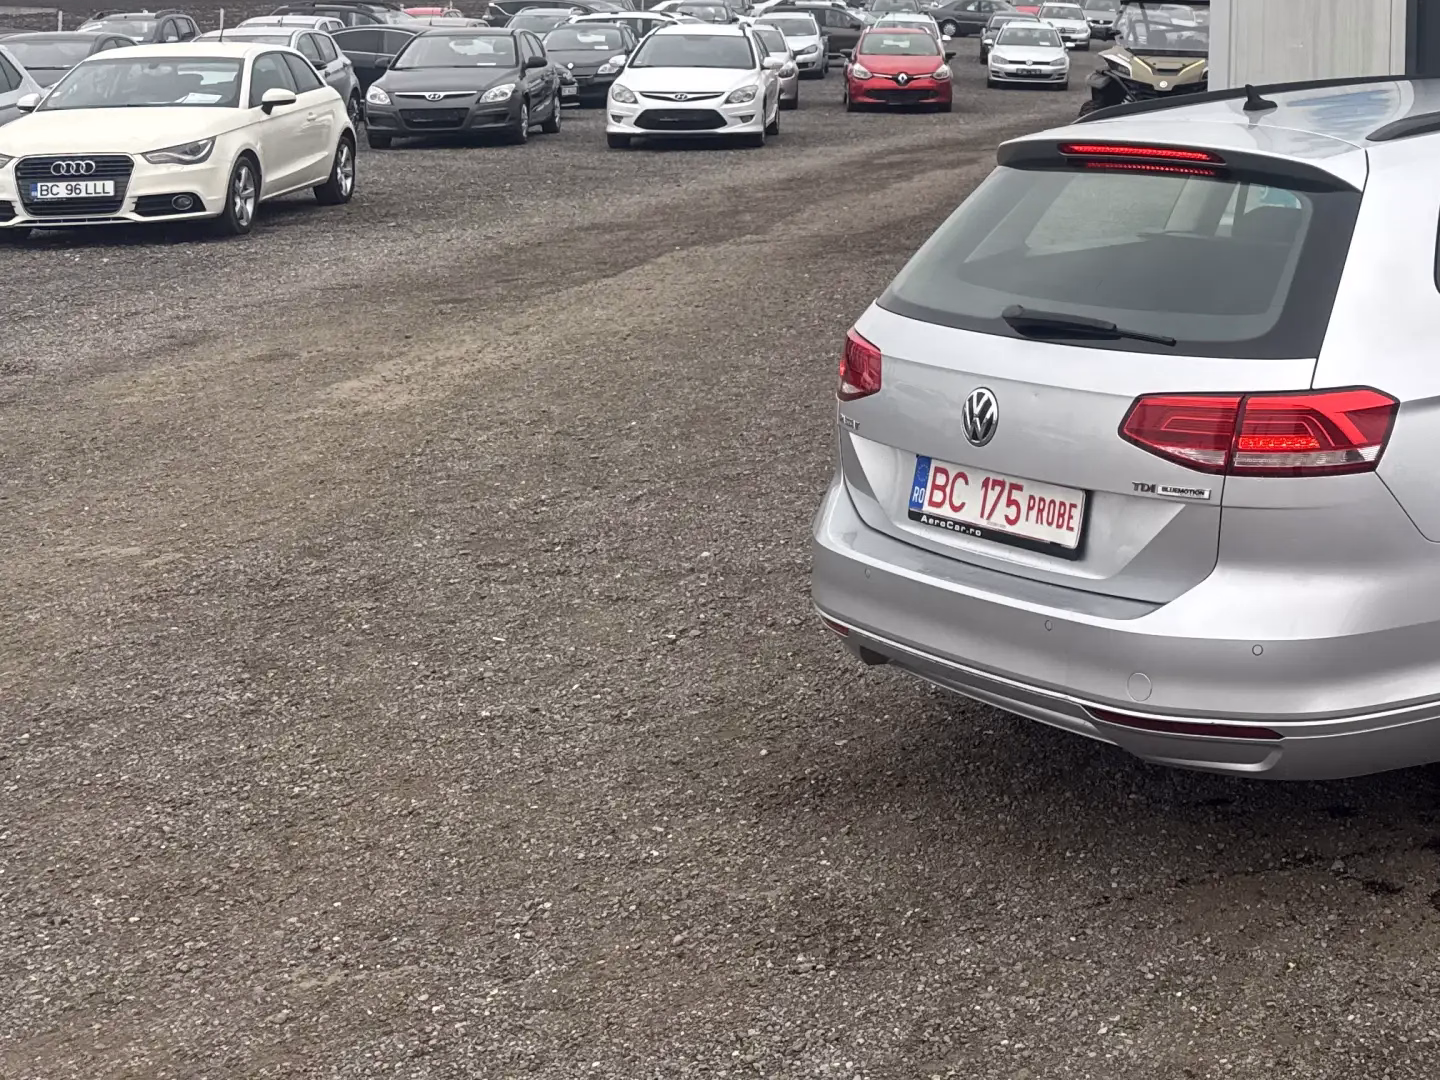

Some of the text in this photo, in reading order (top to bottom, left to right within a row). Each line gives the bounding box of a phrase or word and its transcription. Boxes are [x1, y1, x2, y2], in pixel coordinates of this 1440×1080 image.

[40, 184, 60, 196] BC
[65, 183, 82, 196] 96
[85, 183, 110, 195] LLL
[1132, 481, 1205, 496] TDI BLUEMOTION
[912, 466, 1078, 532] RO BC 175 PROBE
[920, 514, 983, 538] AeroCar.ro
